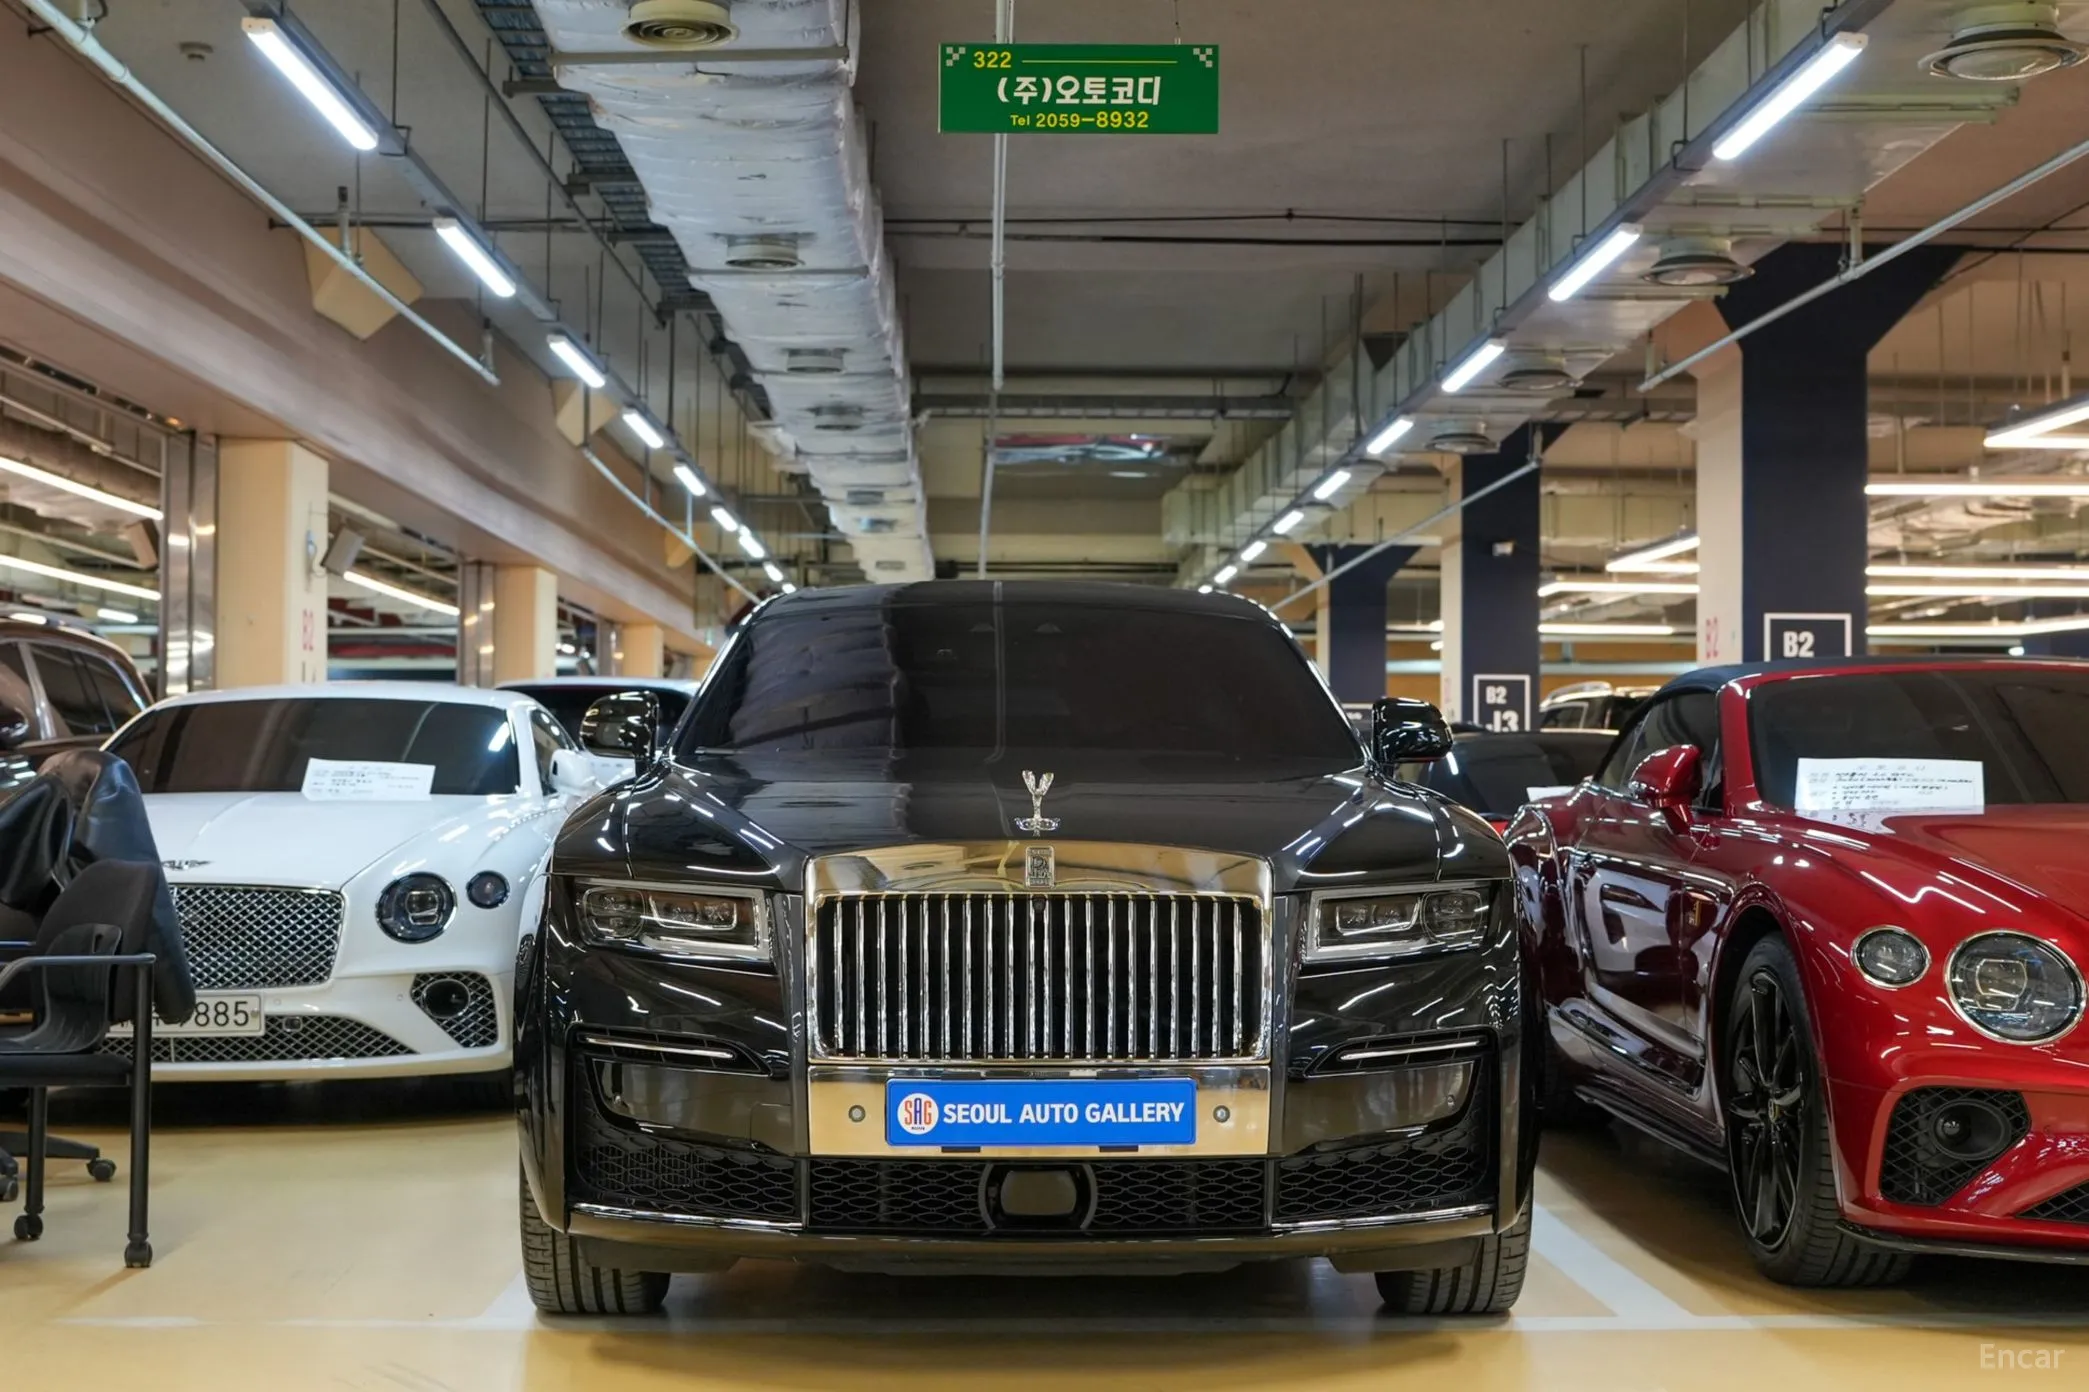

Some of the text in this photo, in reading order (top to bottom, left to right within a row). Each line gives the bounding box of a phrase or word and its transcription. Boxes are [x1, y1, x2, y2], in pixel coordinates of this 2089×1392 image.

[973, 51, 1012, 68] 322
[997, 75, 1161, 105] (주)오토코디
[1010, 111, 1149, 128] Tel 2059-8932
[1783, 630, 1815, 658] B2
[1485, 685, 1507, 704] B2
[179, 1001, 249, 1027] 885
[904, 1097, 1185, 1125] SAG SEOUL AUTO GALLERY
